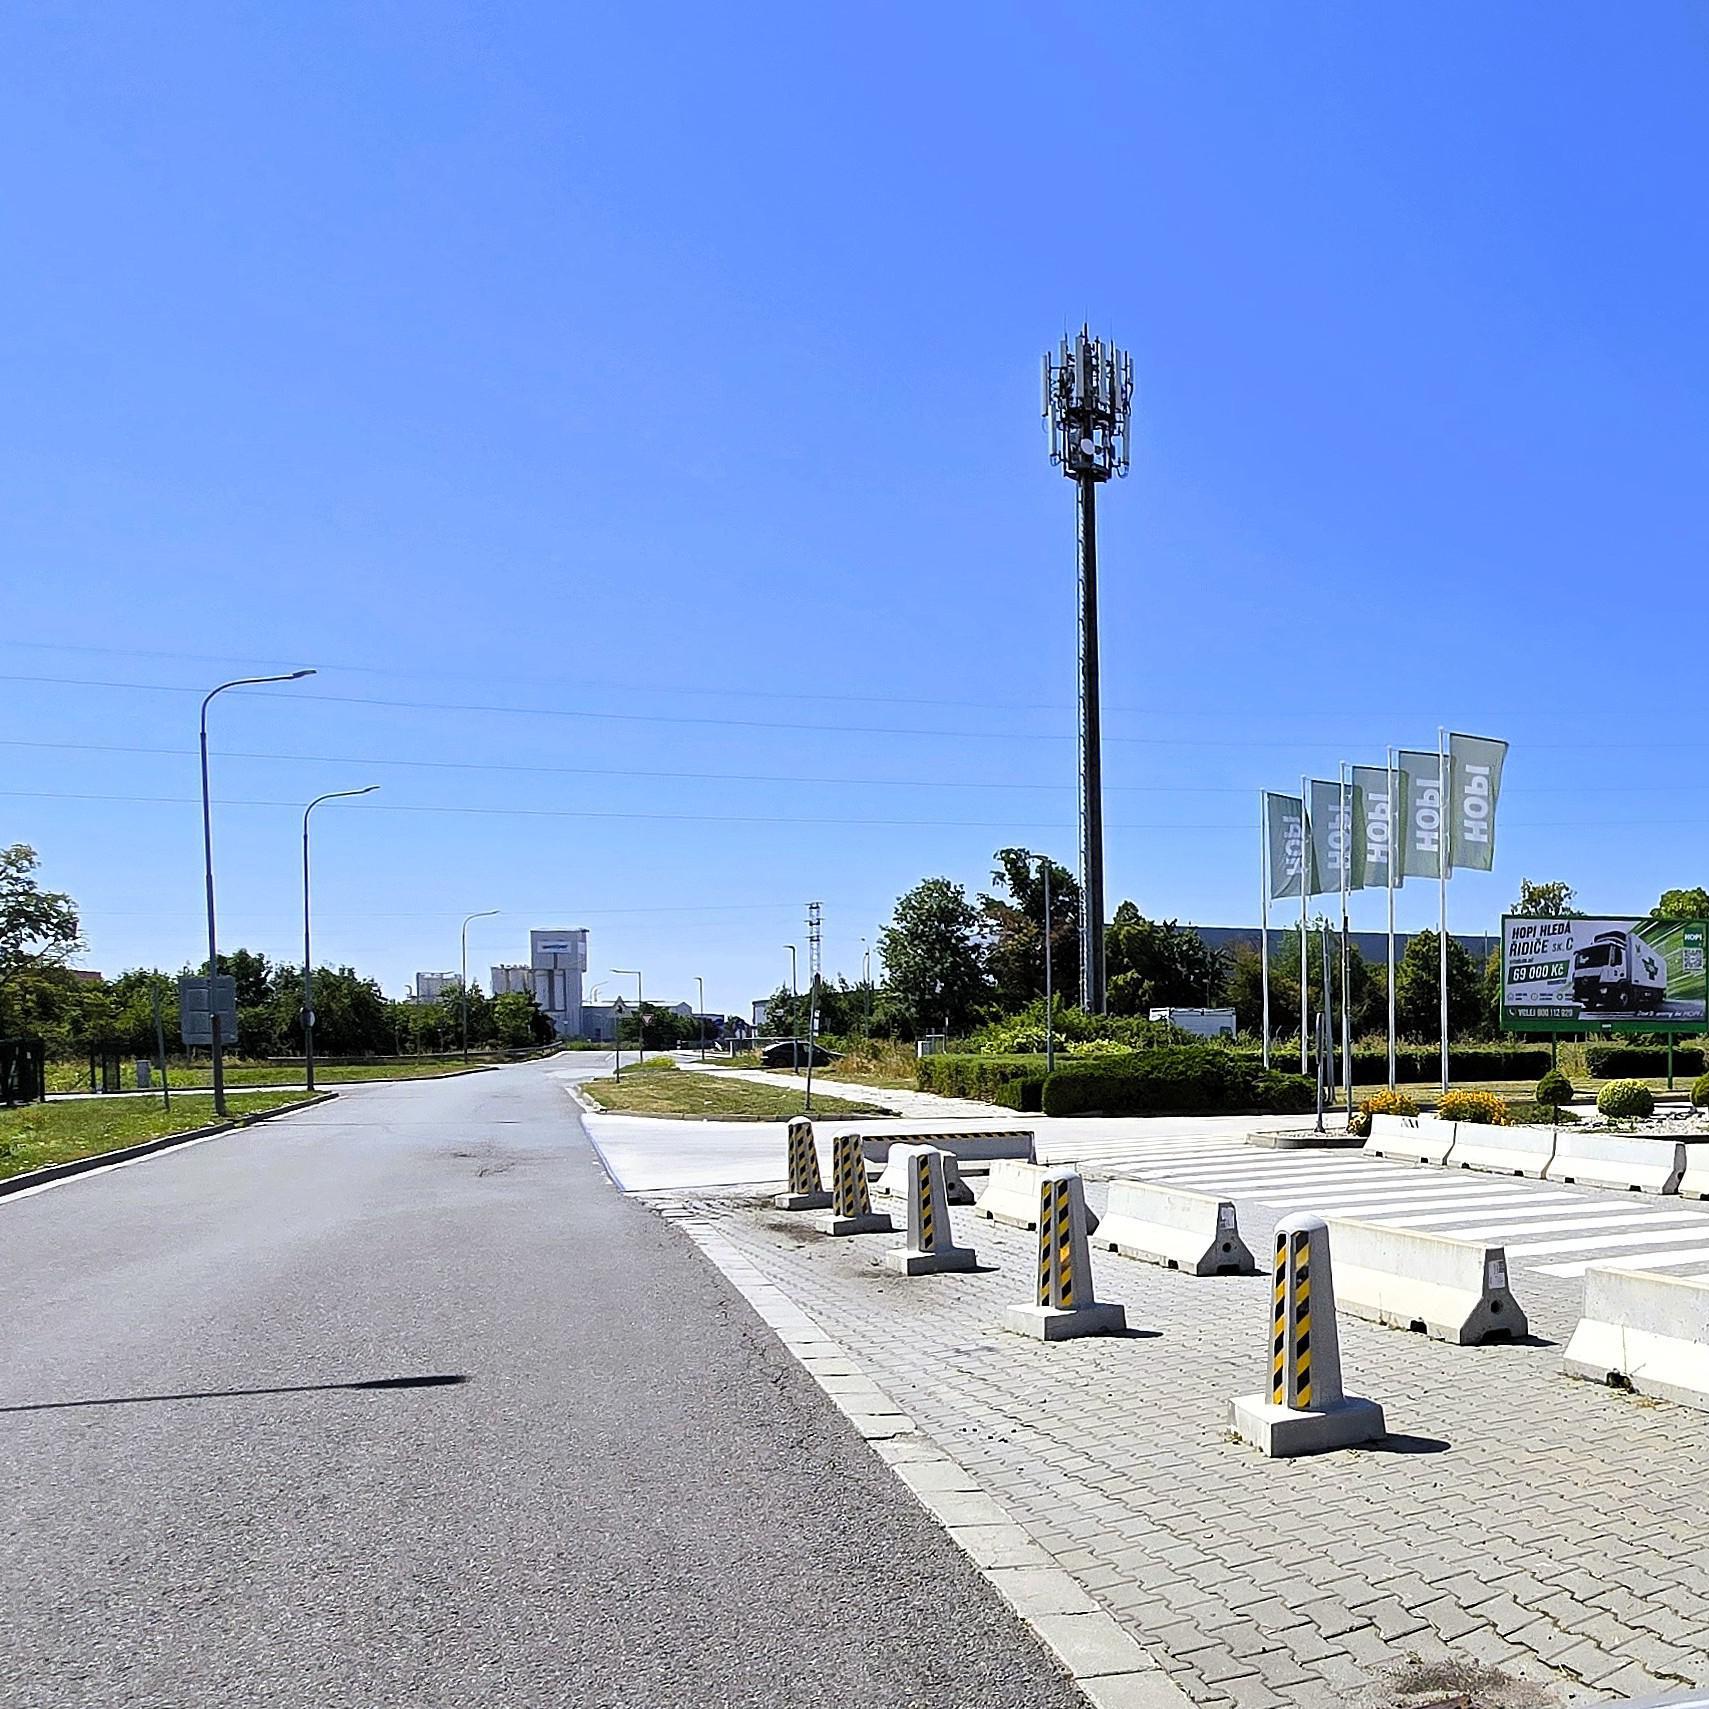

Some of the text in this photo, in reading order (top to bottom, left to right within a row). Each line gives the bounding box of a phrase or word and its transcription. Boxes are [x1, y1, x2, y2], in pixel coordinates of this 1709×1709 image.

[1512, 925, 1537, 939] HOPI
[1509, 938, 1549, 957] ŘIDIČE
[1513, 963, 1564, 981] 69 000 Kč
